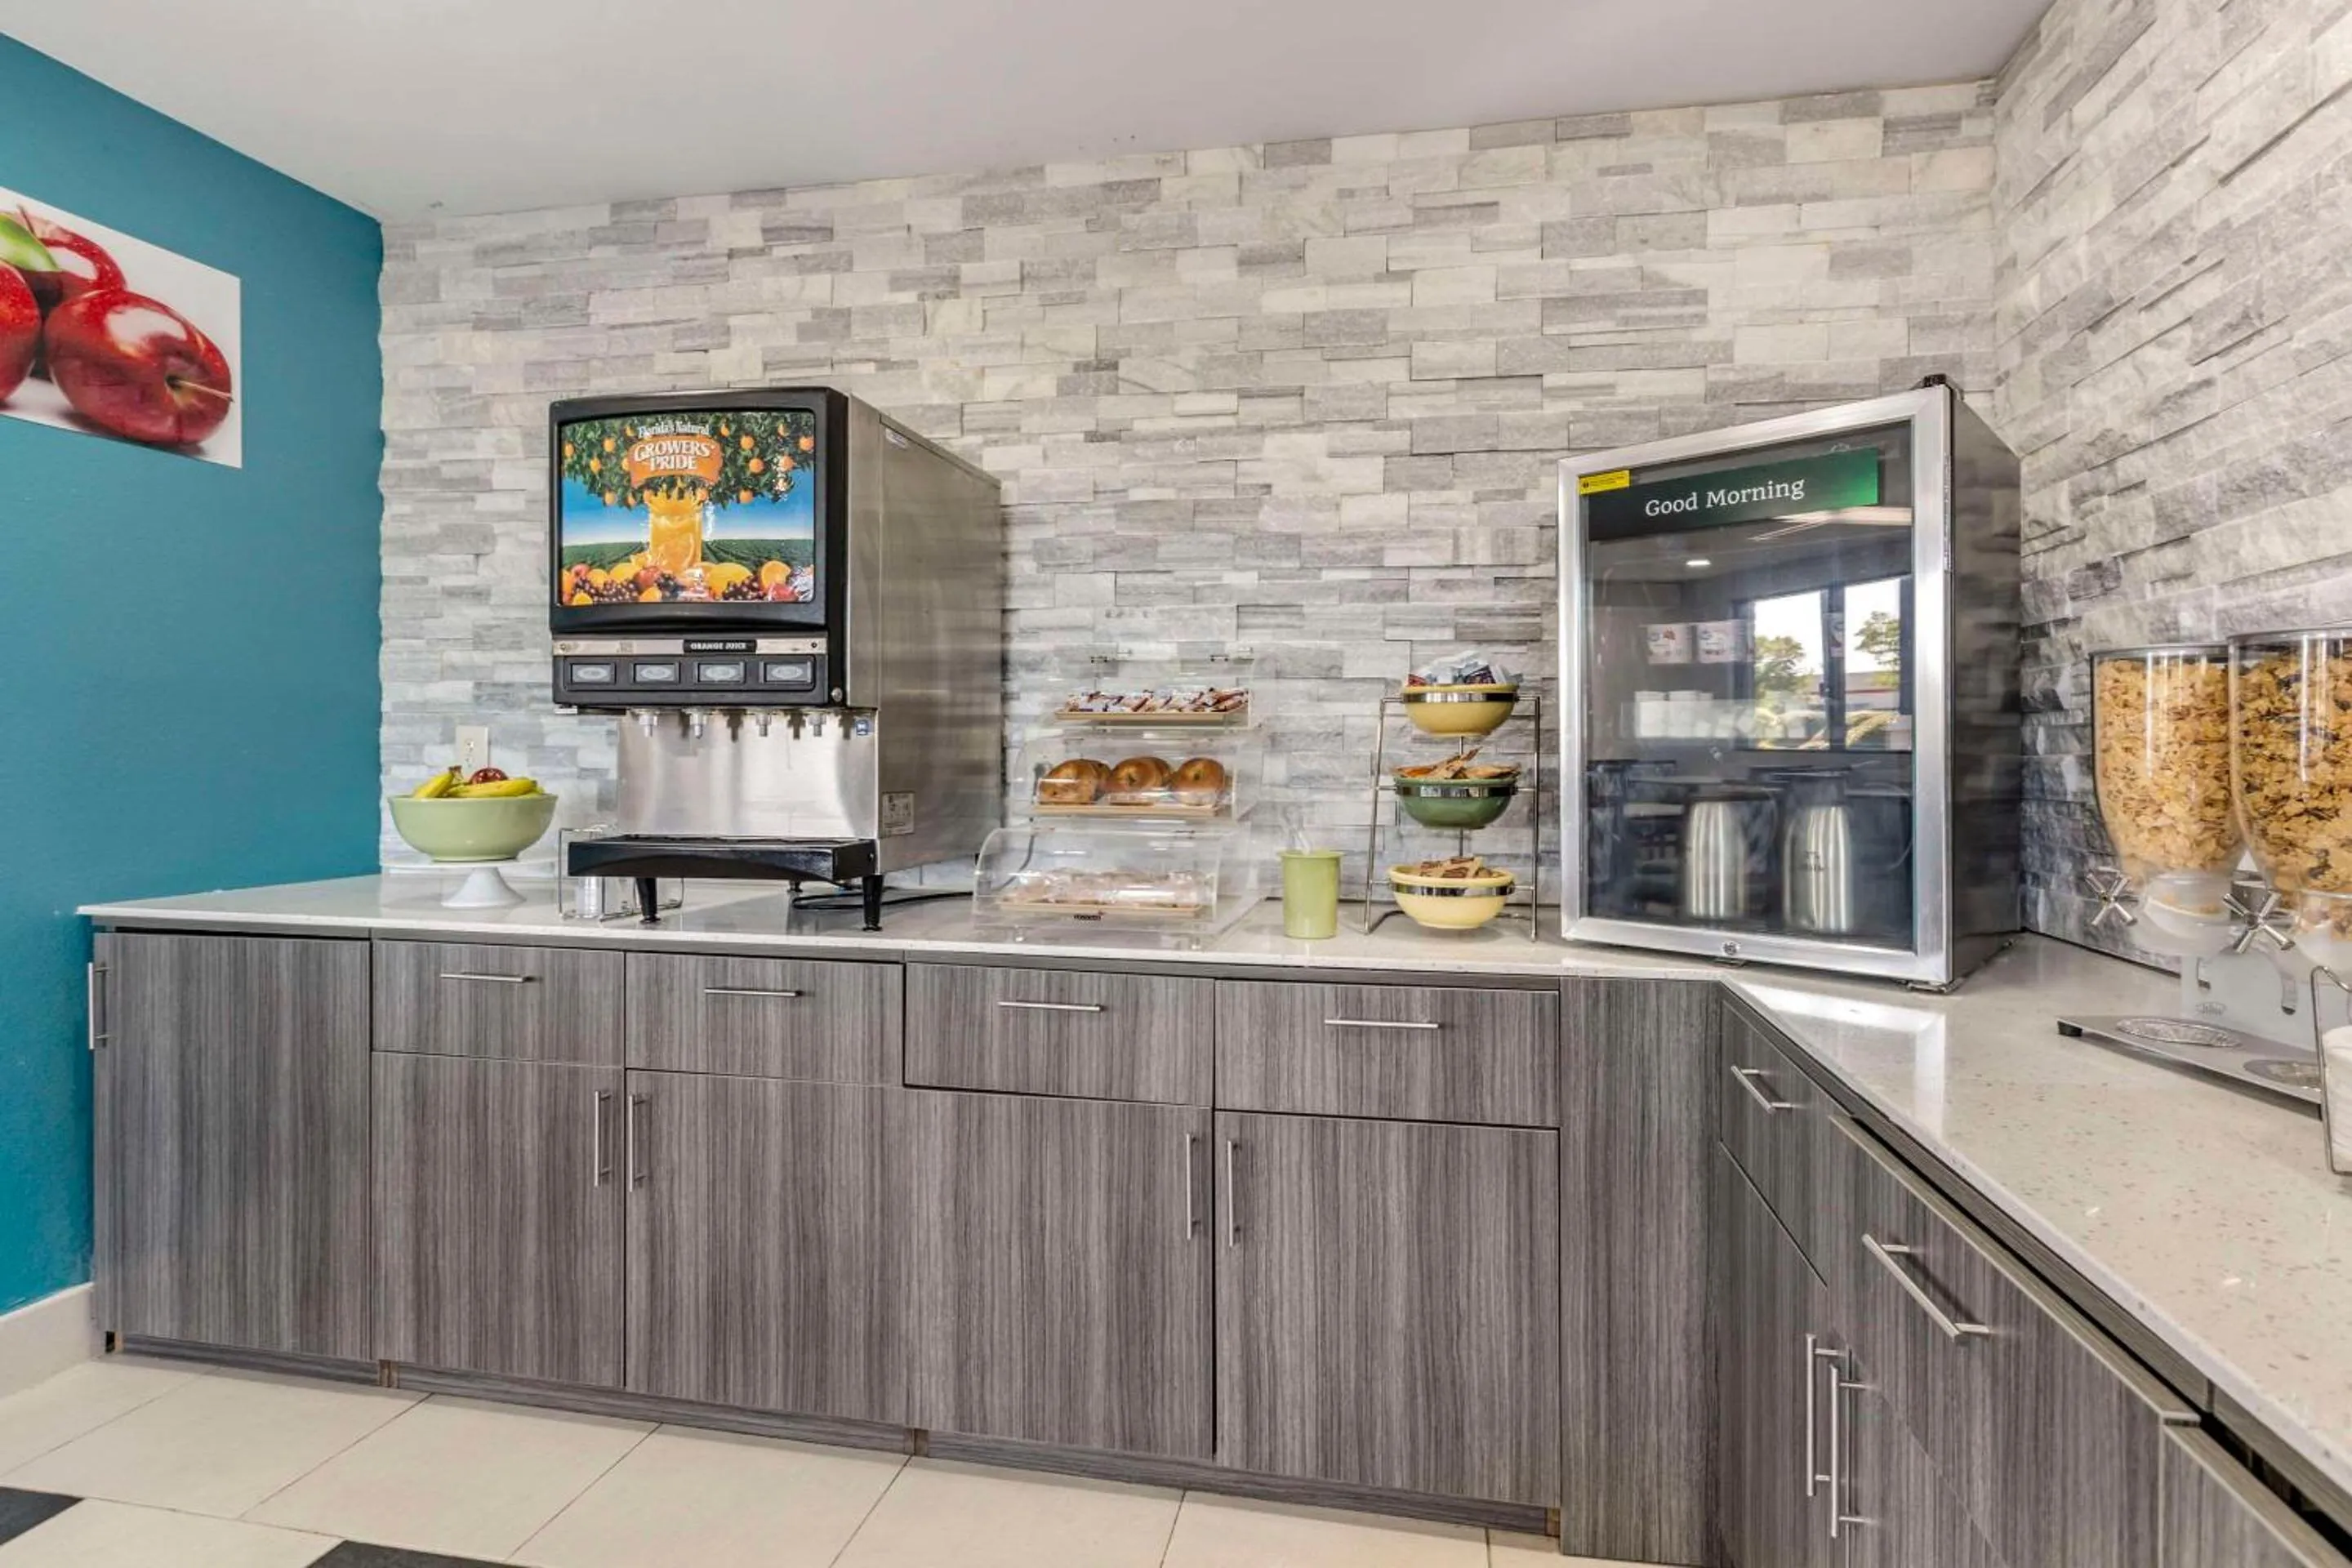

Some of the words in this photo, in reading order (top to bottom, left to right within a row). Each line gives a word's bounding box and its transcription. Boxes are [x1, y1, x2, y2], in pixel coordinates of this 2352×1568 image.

[675, 421, 710, 435] Natural
[649, 455, 697, 471] PRIDE
[1646, 492, 1699, 516] Good
[1705, 479, 1805, 508] Morning
